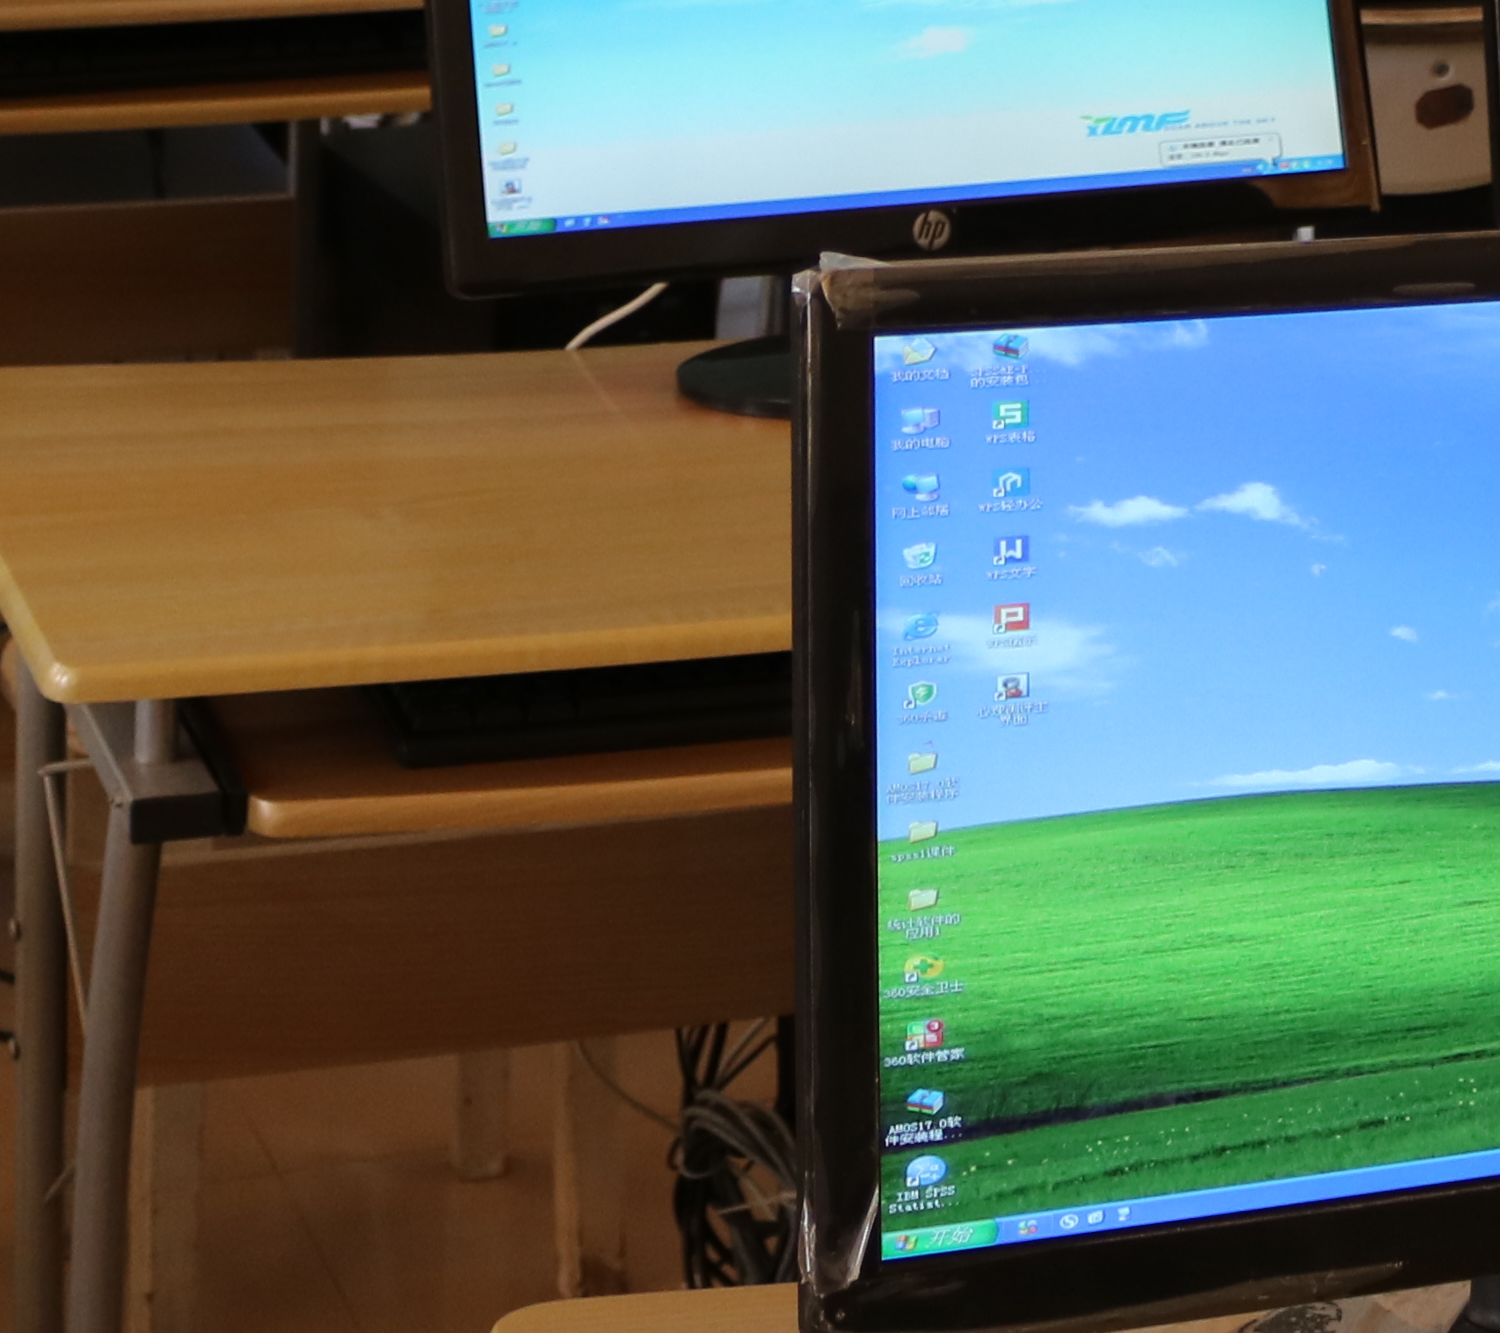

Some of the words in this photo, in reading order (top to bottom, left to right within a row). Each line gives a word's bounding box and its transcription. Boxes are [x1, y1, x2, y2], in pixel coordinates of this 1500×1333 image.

[916, 211, 948, 251] hp
[891, 368, 950, 382] 我的文档
[891, 438, 950, 451] 我的电脑
[892, 504, 949, 519] 网上邻居
[892, 644, 950, 656] Internet
[885, 980, 964, 998] 360安全卫士
[884, 1048, 965, 1067] 360软件管家
[896, 1191, 919, 1203] IBM
[925, 1185, 956, 1198] SPSS
[926, 1225, 974, 1248] 开始
